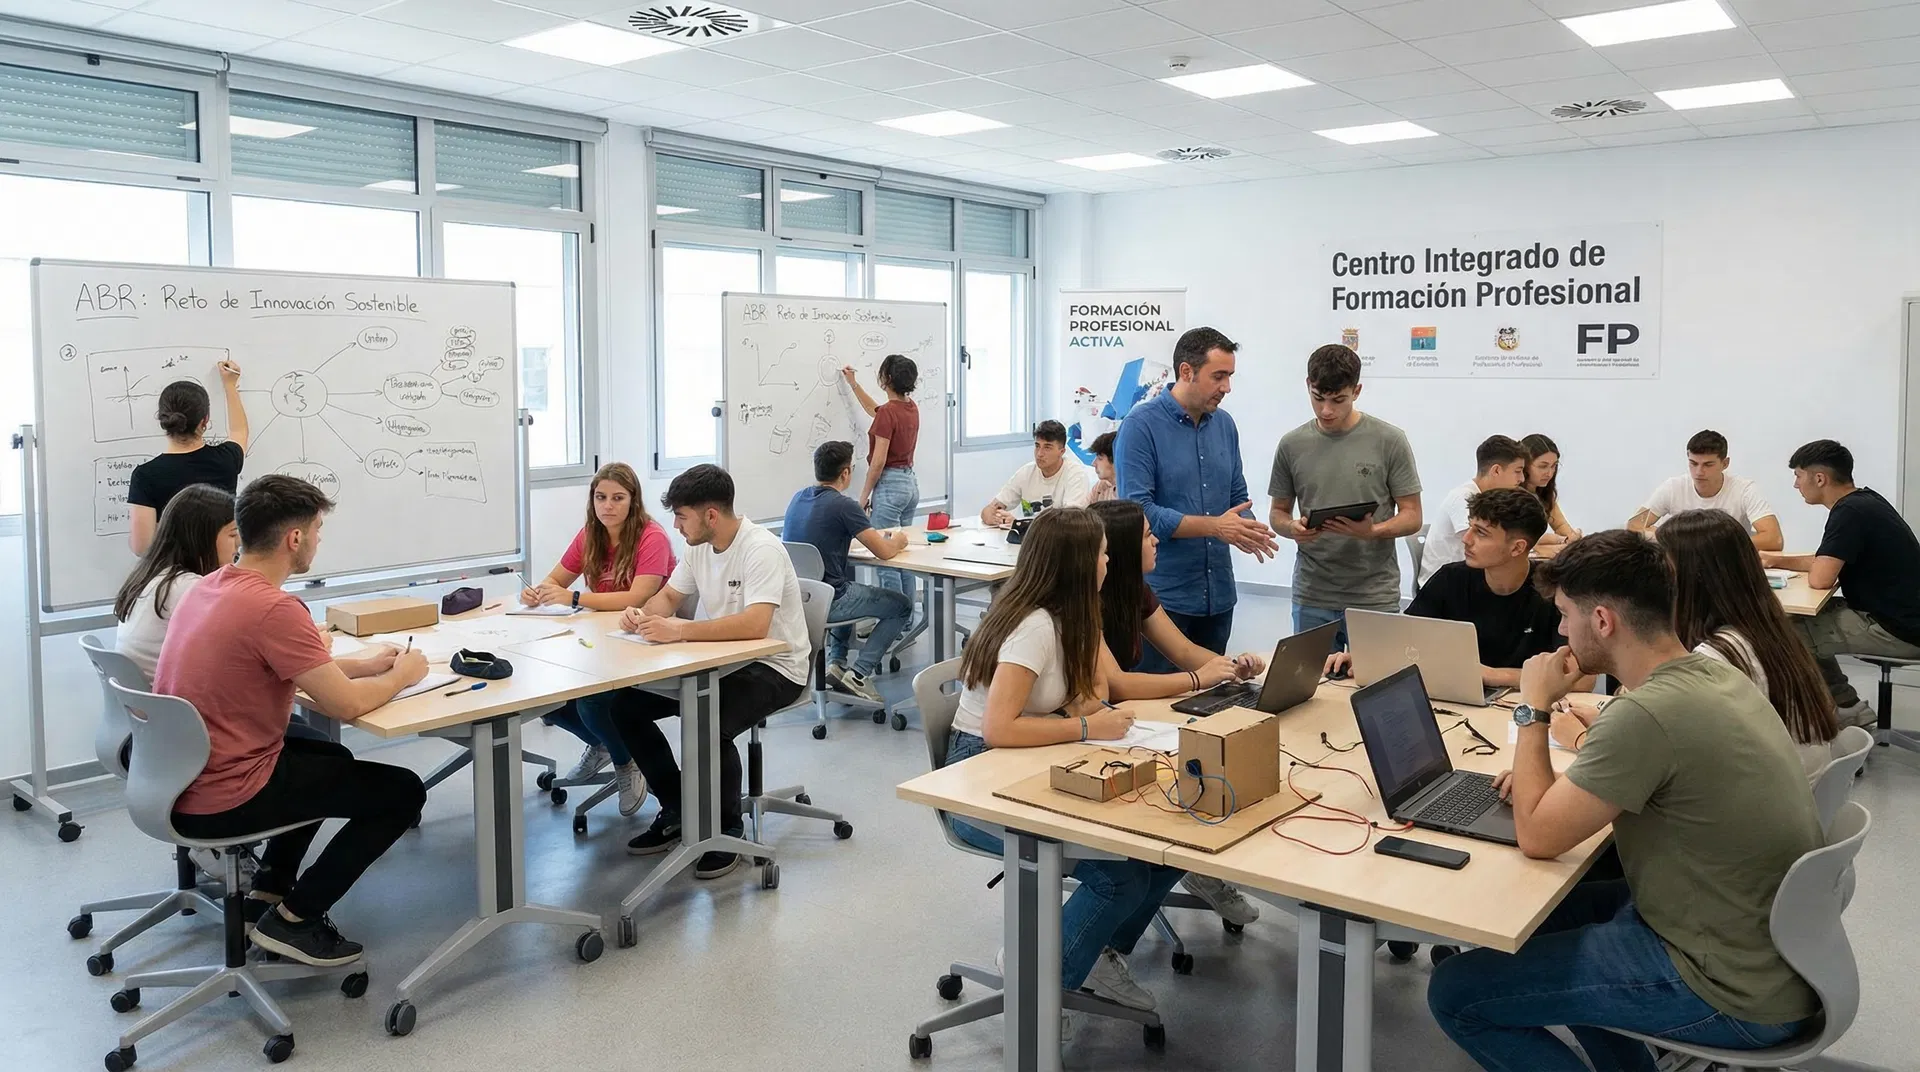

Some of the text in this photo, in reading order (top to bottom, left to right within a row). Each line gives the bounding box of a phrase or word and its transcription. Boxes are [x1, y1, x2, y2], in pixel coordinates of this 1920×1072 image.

[1332, 240, 1606, 277] Centro Integrado de
[75, 283, 420, 314] ABR: Reto de Innovación Sostenible
[1332, 276, 1641, 310] Formación Profesional
[743, 303, 767, 321] ABR
[776, 304, 796, 320] Reto
[799, 306, 809, 321] de
[1070, 301, 1161, 316] FORMACIÓN
[1069, 320, 1175, 332] PROFESIONAL
[1069, 336, 1125, 348] ACTIVA
[1577, 323, 1640, 354] FP
